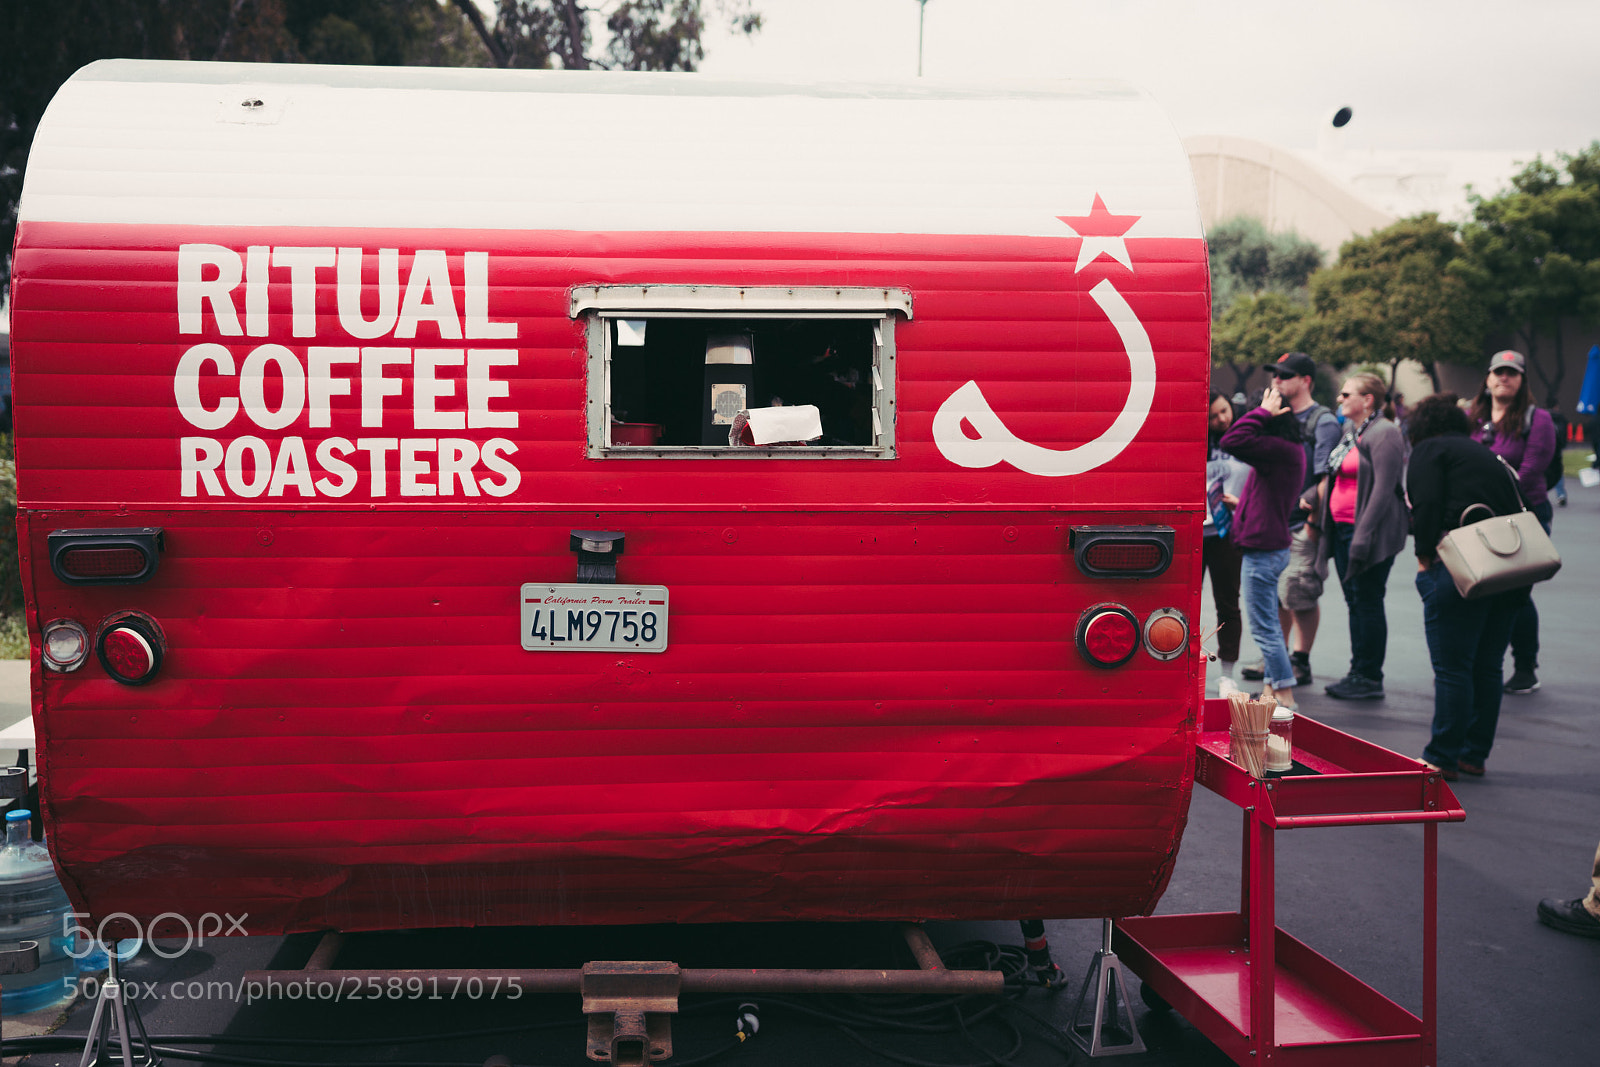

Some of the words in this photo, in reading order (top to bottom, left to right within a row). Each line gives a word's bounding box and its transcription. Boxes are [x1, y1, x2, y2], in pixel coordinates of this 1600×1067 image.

[177, 243, 518, 340] RITUAL
[174, 343, 519, 430] COFFEE
[180, 435, 522, 498] ROASTERS
[531, 609, 657, 642] 4LM9758
[544, 595, 587, 606] California
[590, 596, 613, 605] Perm
[617, 596, 646, 605] Trailer
